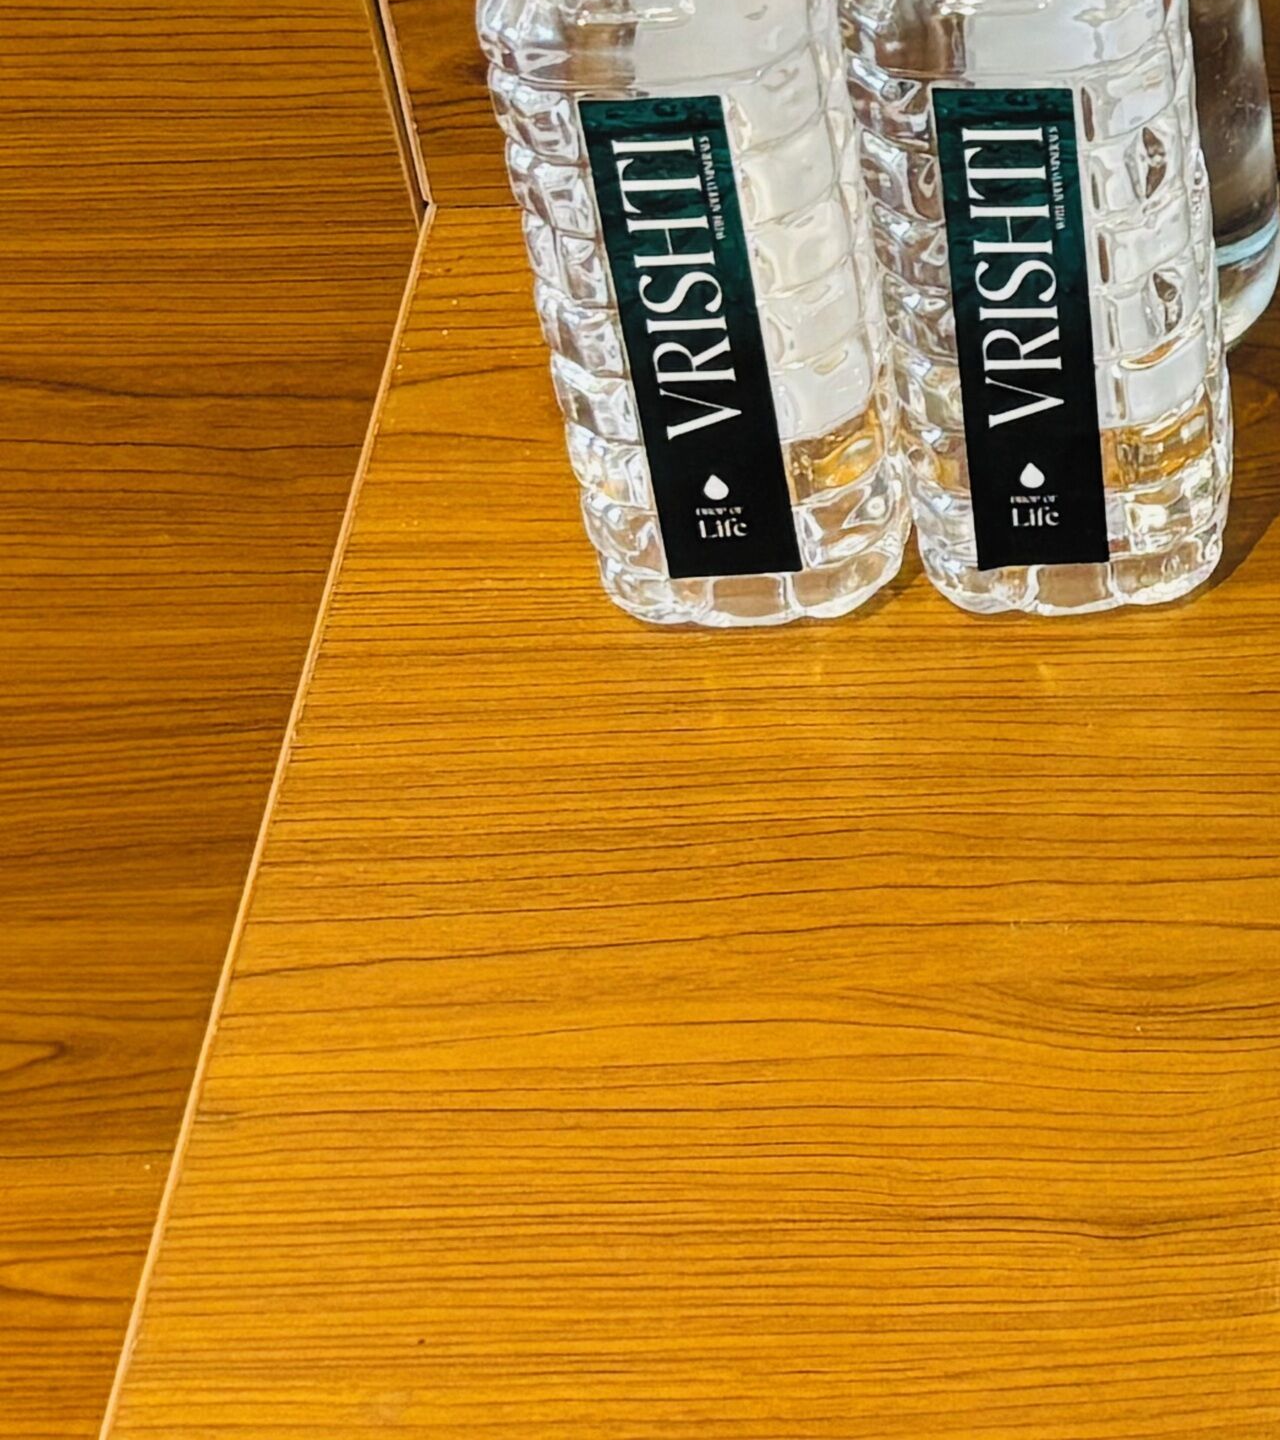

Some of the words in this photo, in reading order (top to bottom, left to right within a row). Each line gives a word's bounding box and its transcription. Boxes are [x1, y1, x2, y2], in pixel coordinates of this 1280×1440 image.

[611, 137, 742, 440] VRISHTI
[961, 127, 1065, 428] VRISHTI
[699, 518, 748, 539] Life
[1011, 505, 1060, 528] Life
